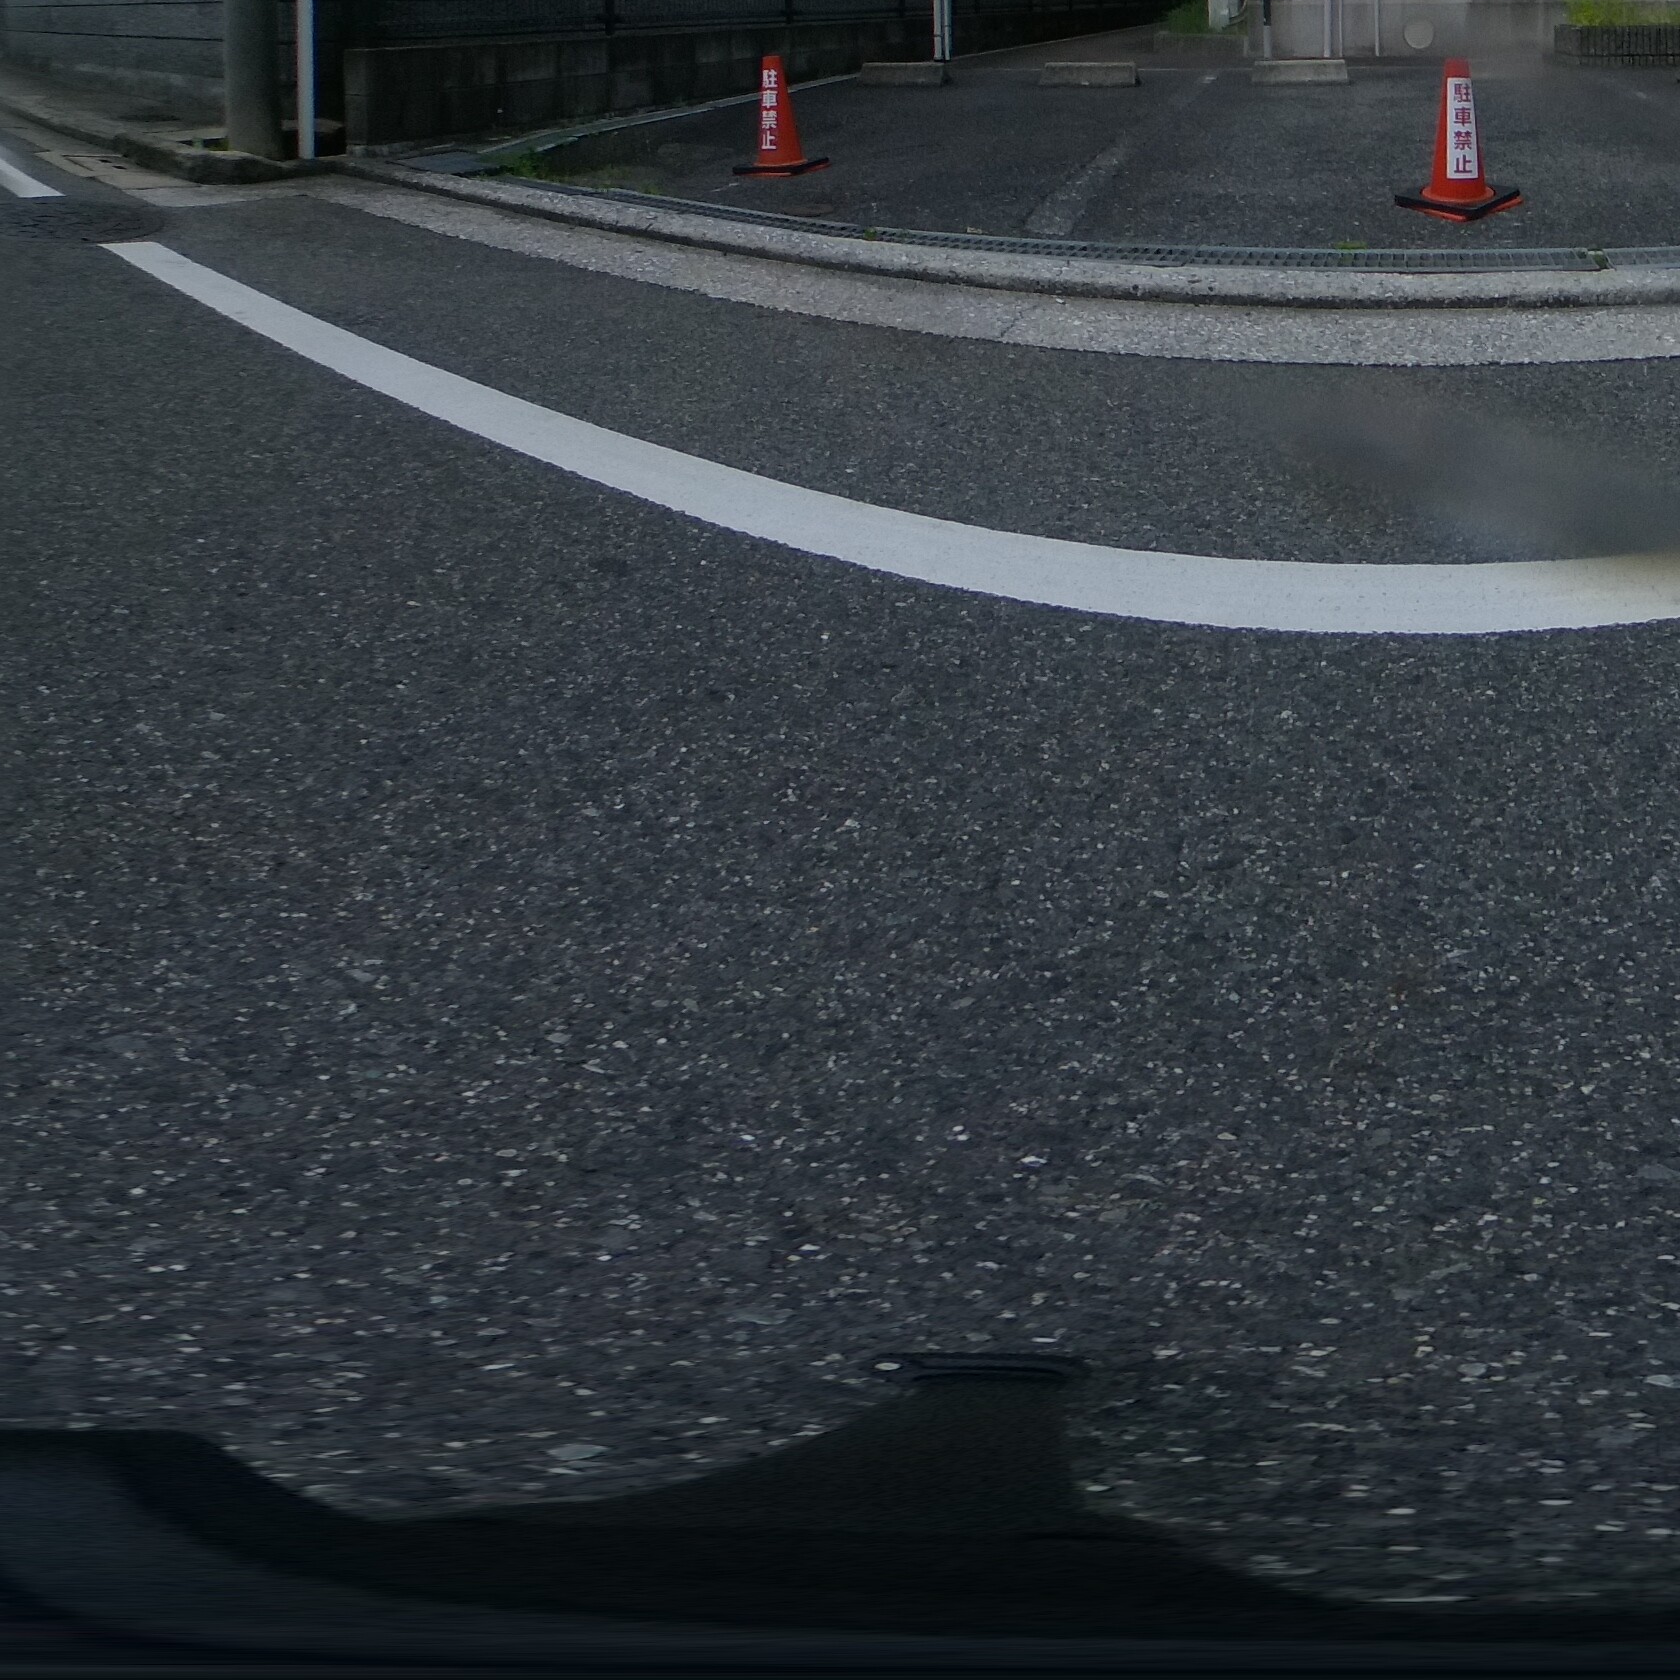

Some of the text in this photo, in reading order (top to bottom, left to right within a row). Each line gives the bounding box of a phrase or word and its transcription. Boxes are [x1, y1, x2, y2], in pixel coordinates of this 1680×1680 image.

[761, 69, 778, 150] 駐車禁止
[1454, 83, 1473, 174] 駐車禁止
